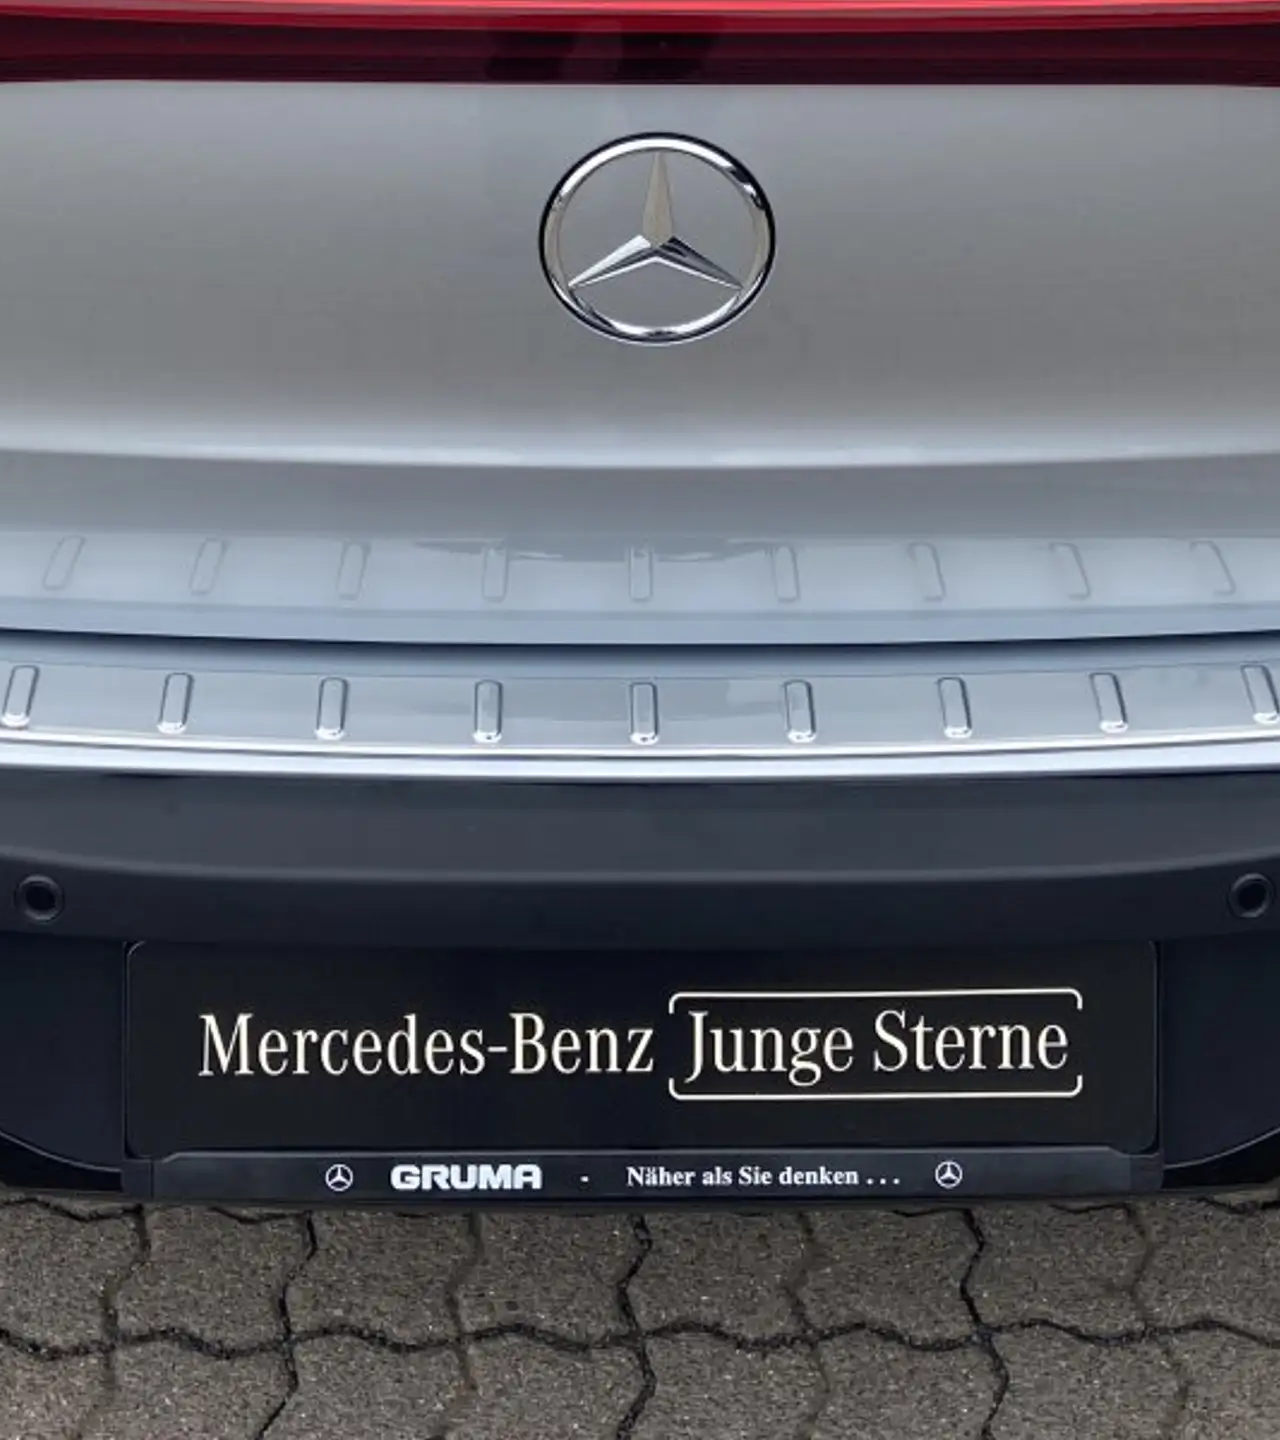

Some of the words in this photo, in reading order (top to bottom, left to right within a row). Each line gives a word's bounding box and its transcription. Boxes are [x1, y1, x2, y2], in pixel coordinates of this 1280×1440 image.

[198, 1012, 655, 1077] Mercedes-Benz
[684, 1009, 854, 1087] Junge
[873, 1009, 1068, 1073] Sterne
[390, 1164, 543, 1191] GRUMA
[626, 1165, 697, 1188] Näher
[702, 1165, 733, 1187] als
[738, 1165, 773, 1187] Sie
